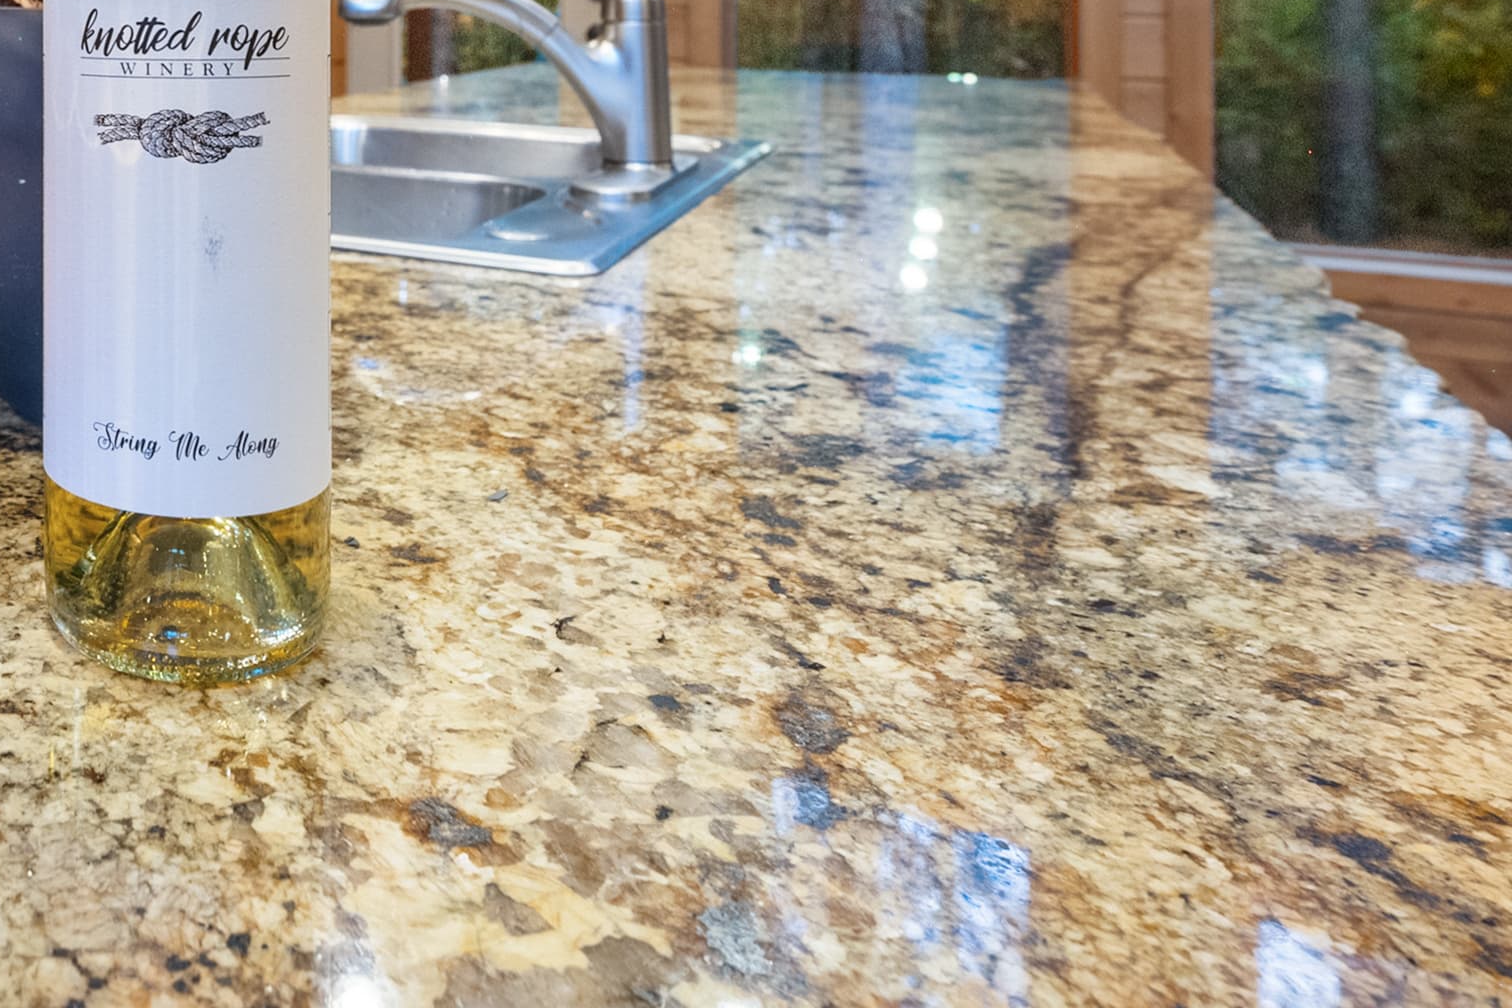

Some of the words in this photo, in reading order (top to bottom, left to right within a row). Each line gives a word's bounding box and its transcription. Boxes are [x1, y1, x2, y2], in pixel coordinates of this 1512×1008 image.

[80, 8, 202, 57] knotted
[208, 24, 290, 71] rope
[120, 62, 236, 77] WINERY
[93, 422, 161, 460] String
[168, 431, 209, 461] Me
[217, 430, 279, 461] Along
